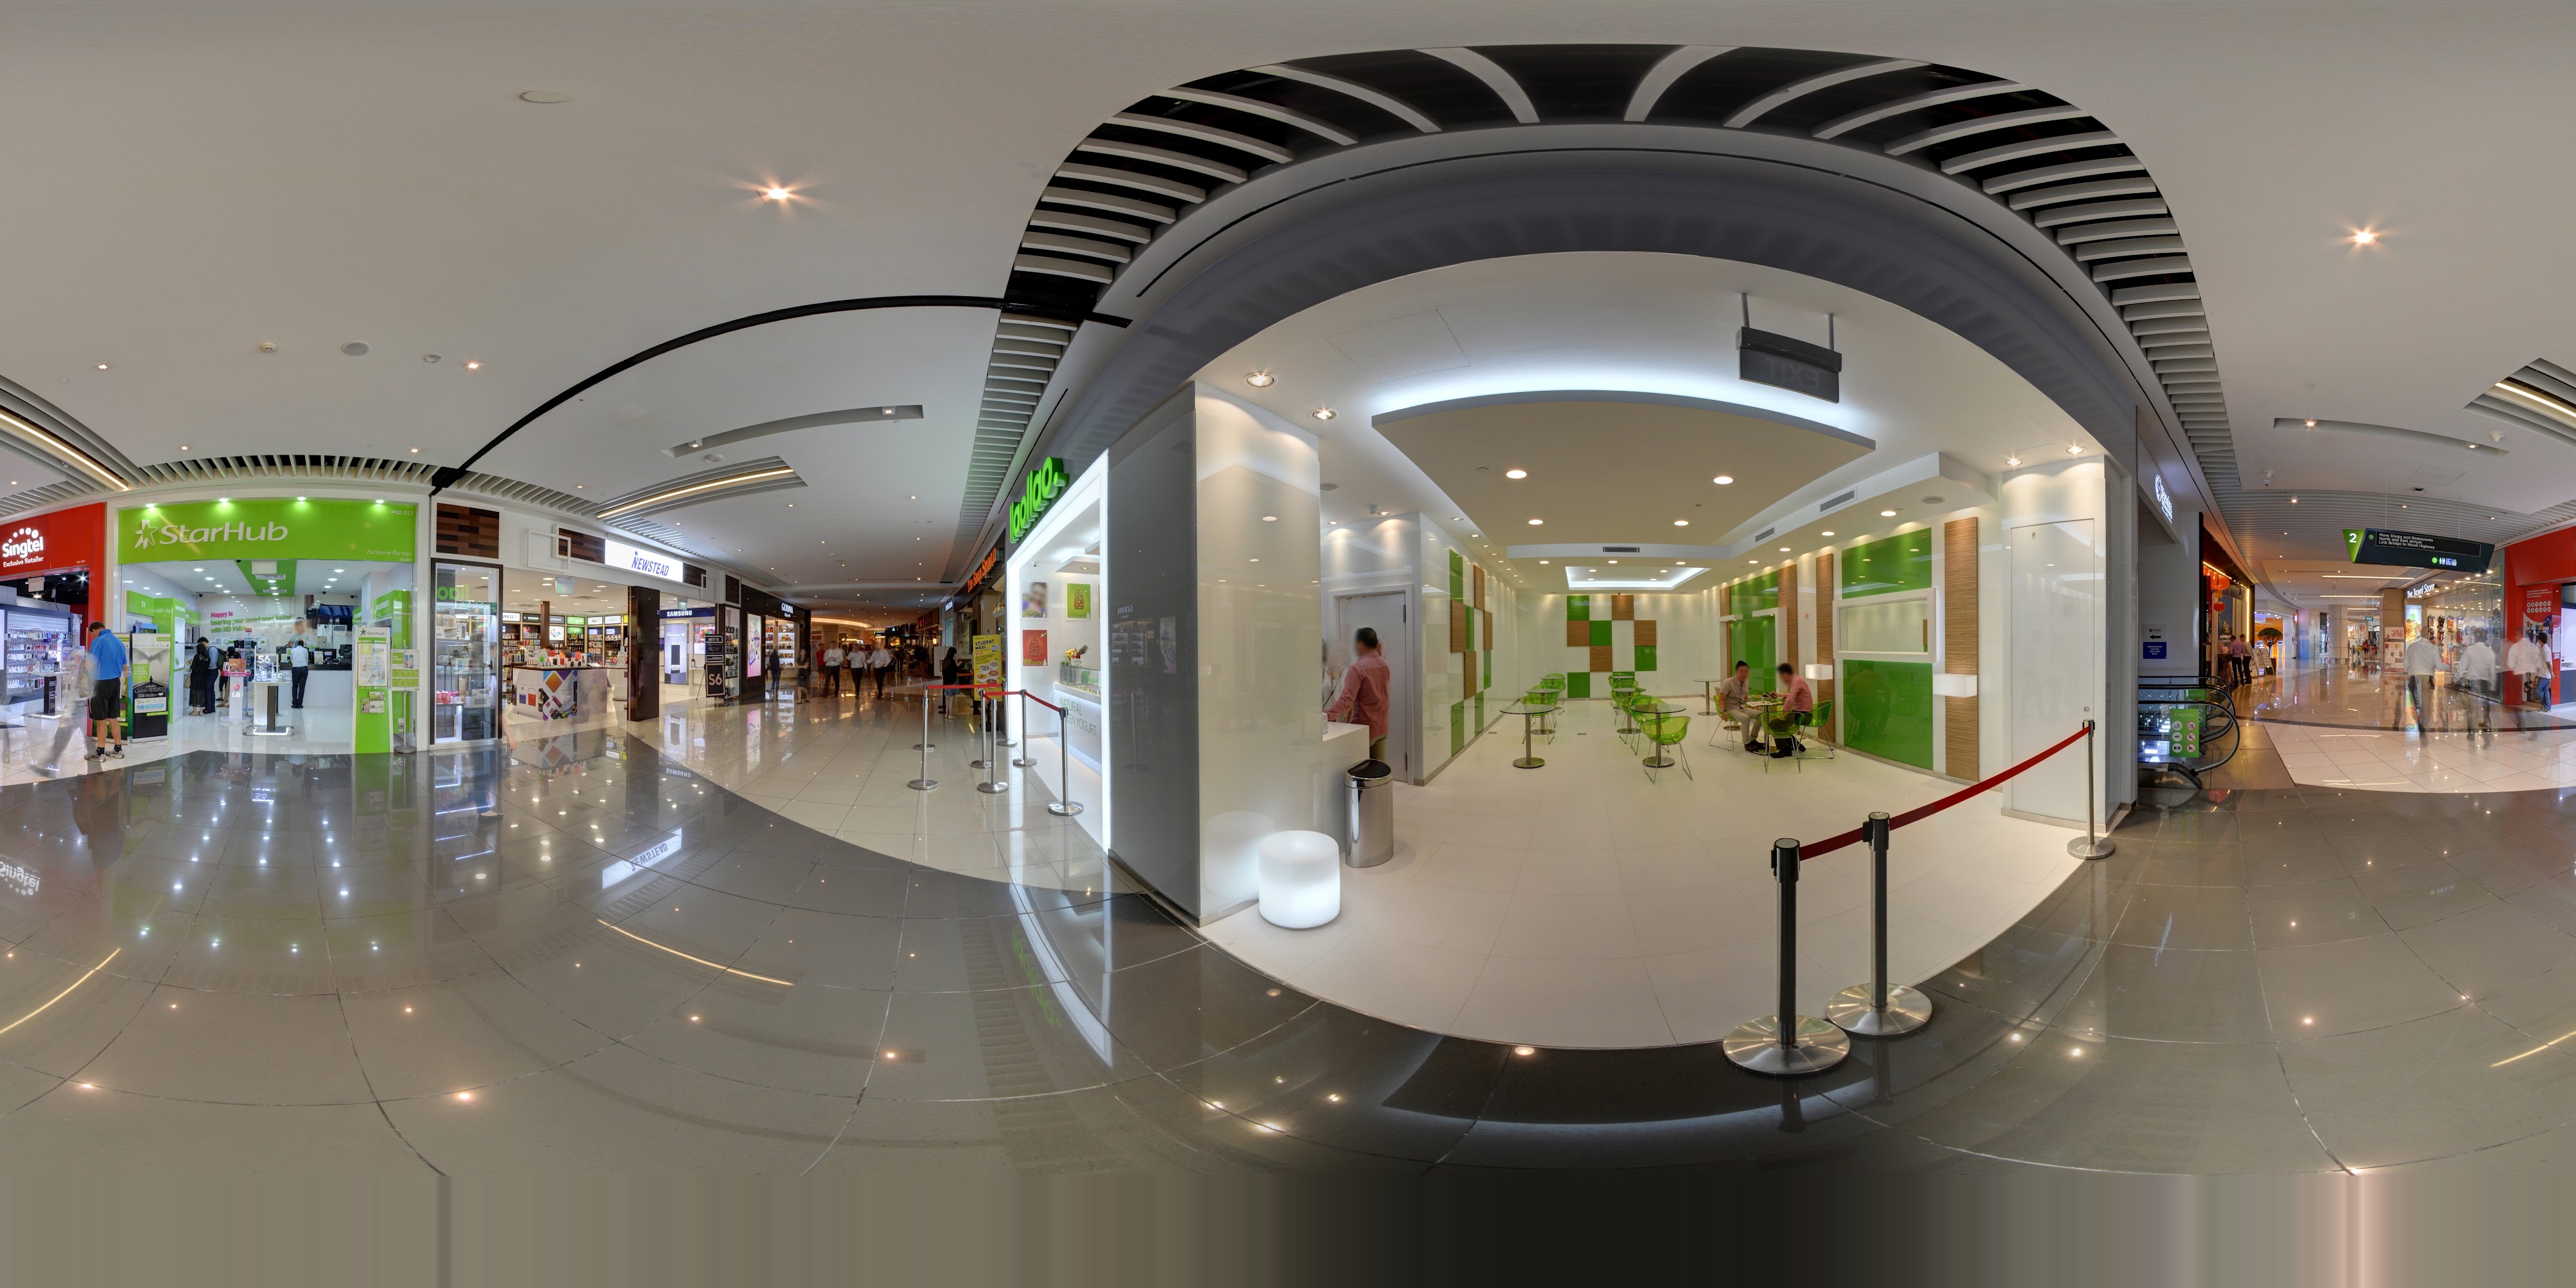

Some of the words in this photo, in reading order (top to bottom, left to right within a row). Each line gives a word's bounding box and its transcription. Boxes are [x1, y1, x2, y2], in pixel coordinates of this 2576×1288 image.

[159, 521, 289, 545] StarHub
[2349, 533, 2357, 543] 2
[2, 536, 44, 558] Singtel
[3, 559, 24, 567] Exclusive
[24, 556, 44, 564] Retailer
[631, 551, 670, 576] NEWSTEAD
[2413, 585, 2423, 596] Travel
[2423, 583, 2434, 593] Store
[781, 602, 793, 614] GODIVA
[258, 655, 270, 664] S6
[708, 673, 723, 685] S6
[1059, 696, 1082, 716] NATURAL
[1076, 717, 1097, 737] YOGURT.
